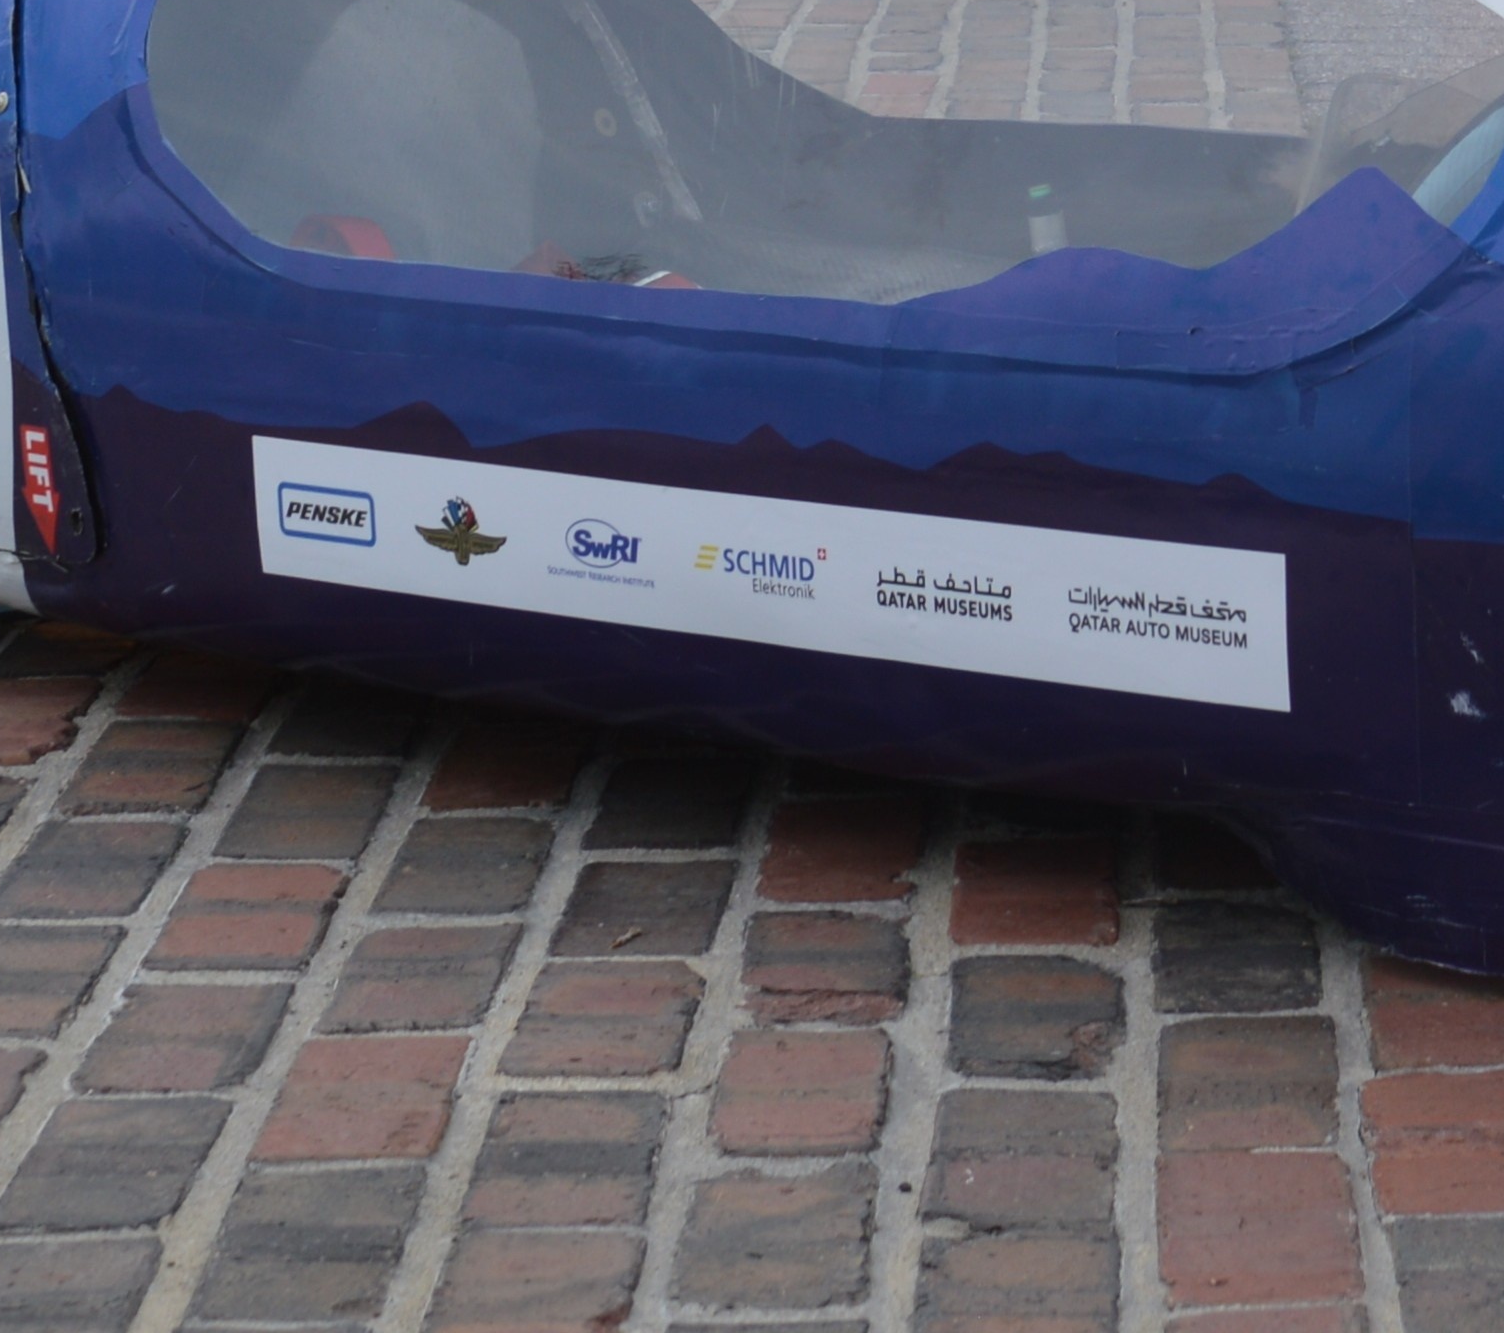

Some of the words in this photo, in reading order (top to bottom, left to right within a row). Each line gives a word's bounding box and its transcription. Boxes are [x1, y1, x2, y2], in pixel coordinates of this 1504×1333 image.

[25, 429, 54, 513] LIFT
[286, 500, 369, 529] PENSKE
[572, 529, 638, 564] SwRI
[723, 547, 815, 582] SCHMID
[876, 566, 926, 589] قطر
[752, 577, 817, 600] Elektronik
[877, 589, 927, 612] QATAR
[933, 595, 1013, 622] MUSEUMS
[1068, 612, 1121, 634] QATAR
[1125, 619, 1170, 640] AUTO
[1174, 624, 1249, 650] MUSEUM
